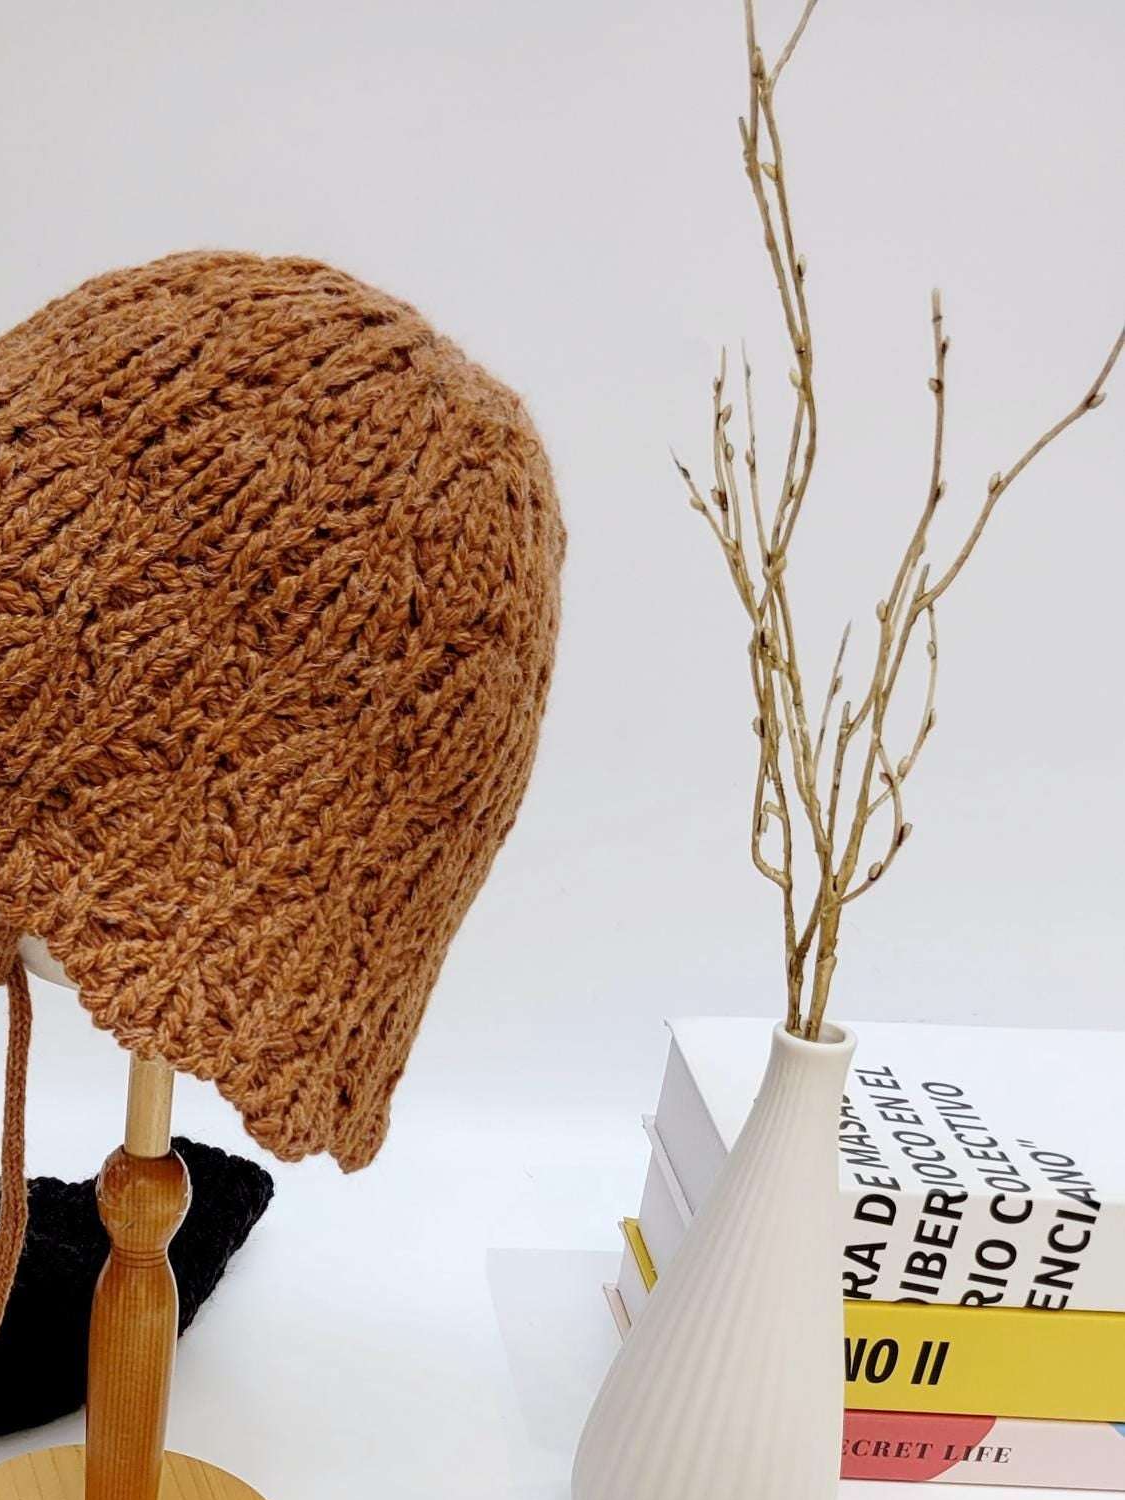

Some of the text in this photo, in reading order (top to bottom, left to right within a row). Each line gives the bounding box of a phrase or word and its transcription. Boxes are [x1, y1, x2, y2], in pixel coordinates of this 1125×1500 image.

[921, 1081, 1033, 1224] COLECTIVO
[853, 1172, 901, 1226] DE
[854, 1065, 969, 1304] IBERIOCO EN EL
[910, 1340, 951, 1386] II
[942, 1444, 1013, 1464] LIFE
